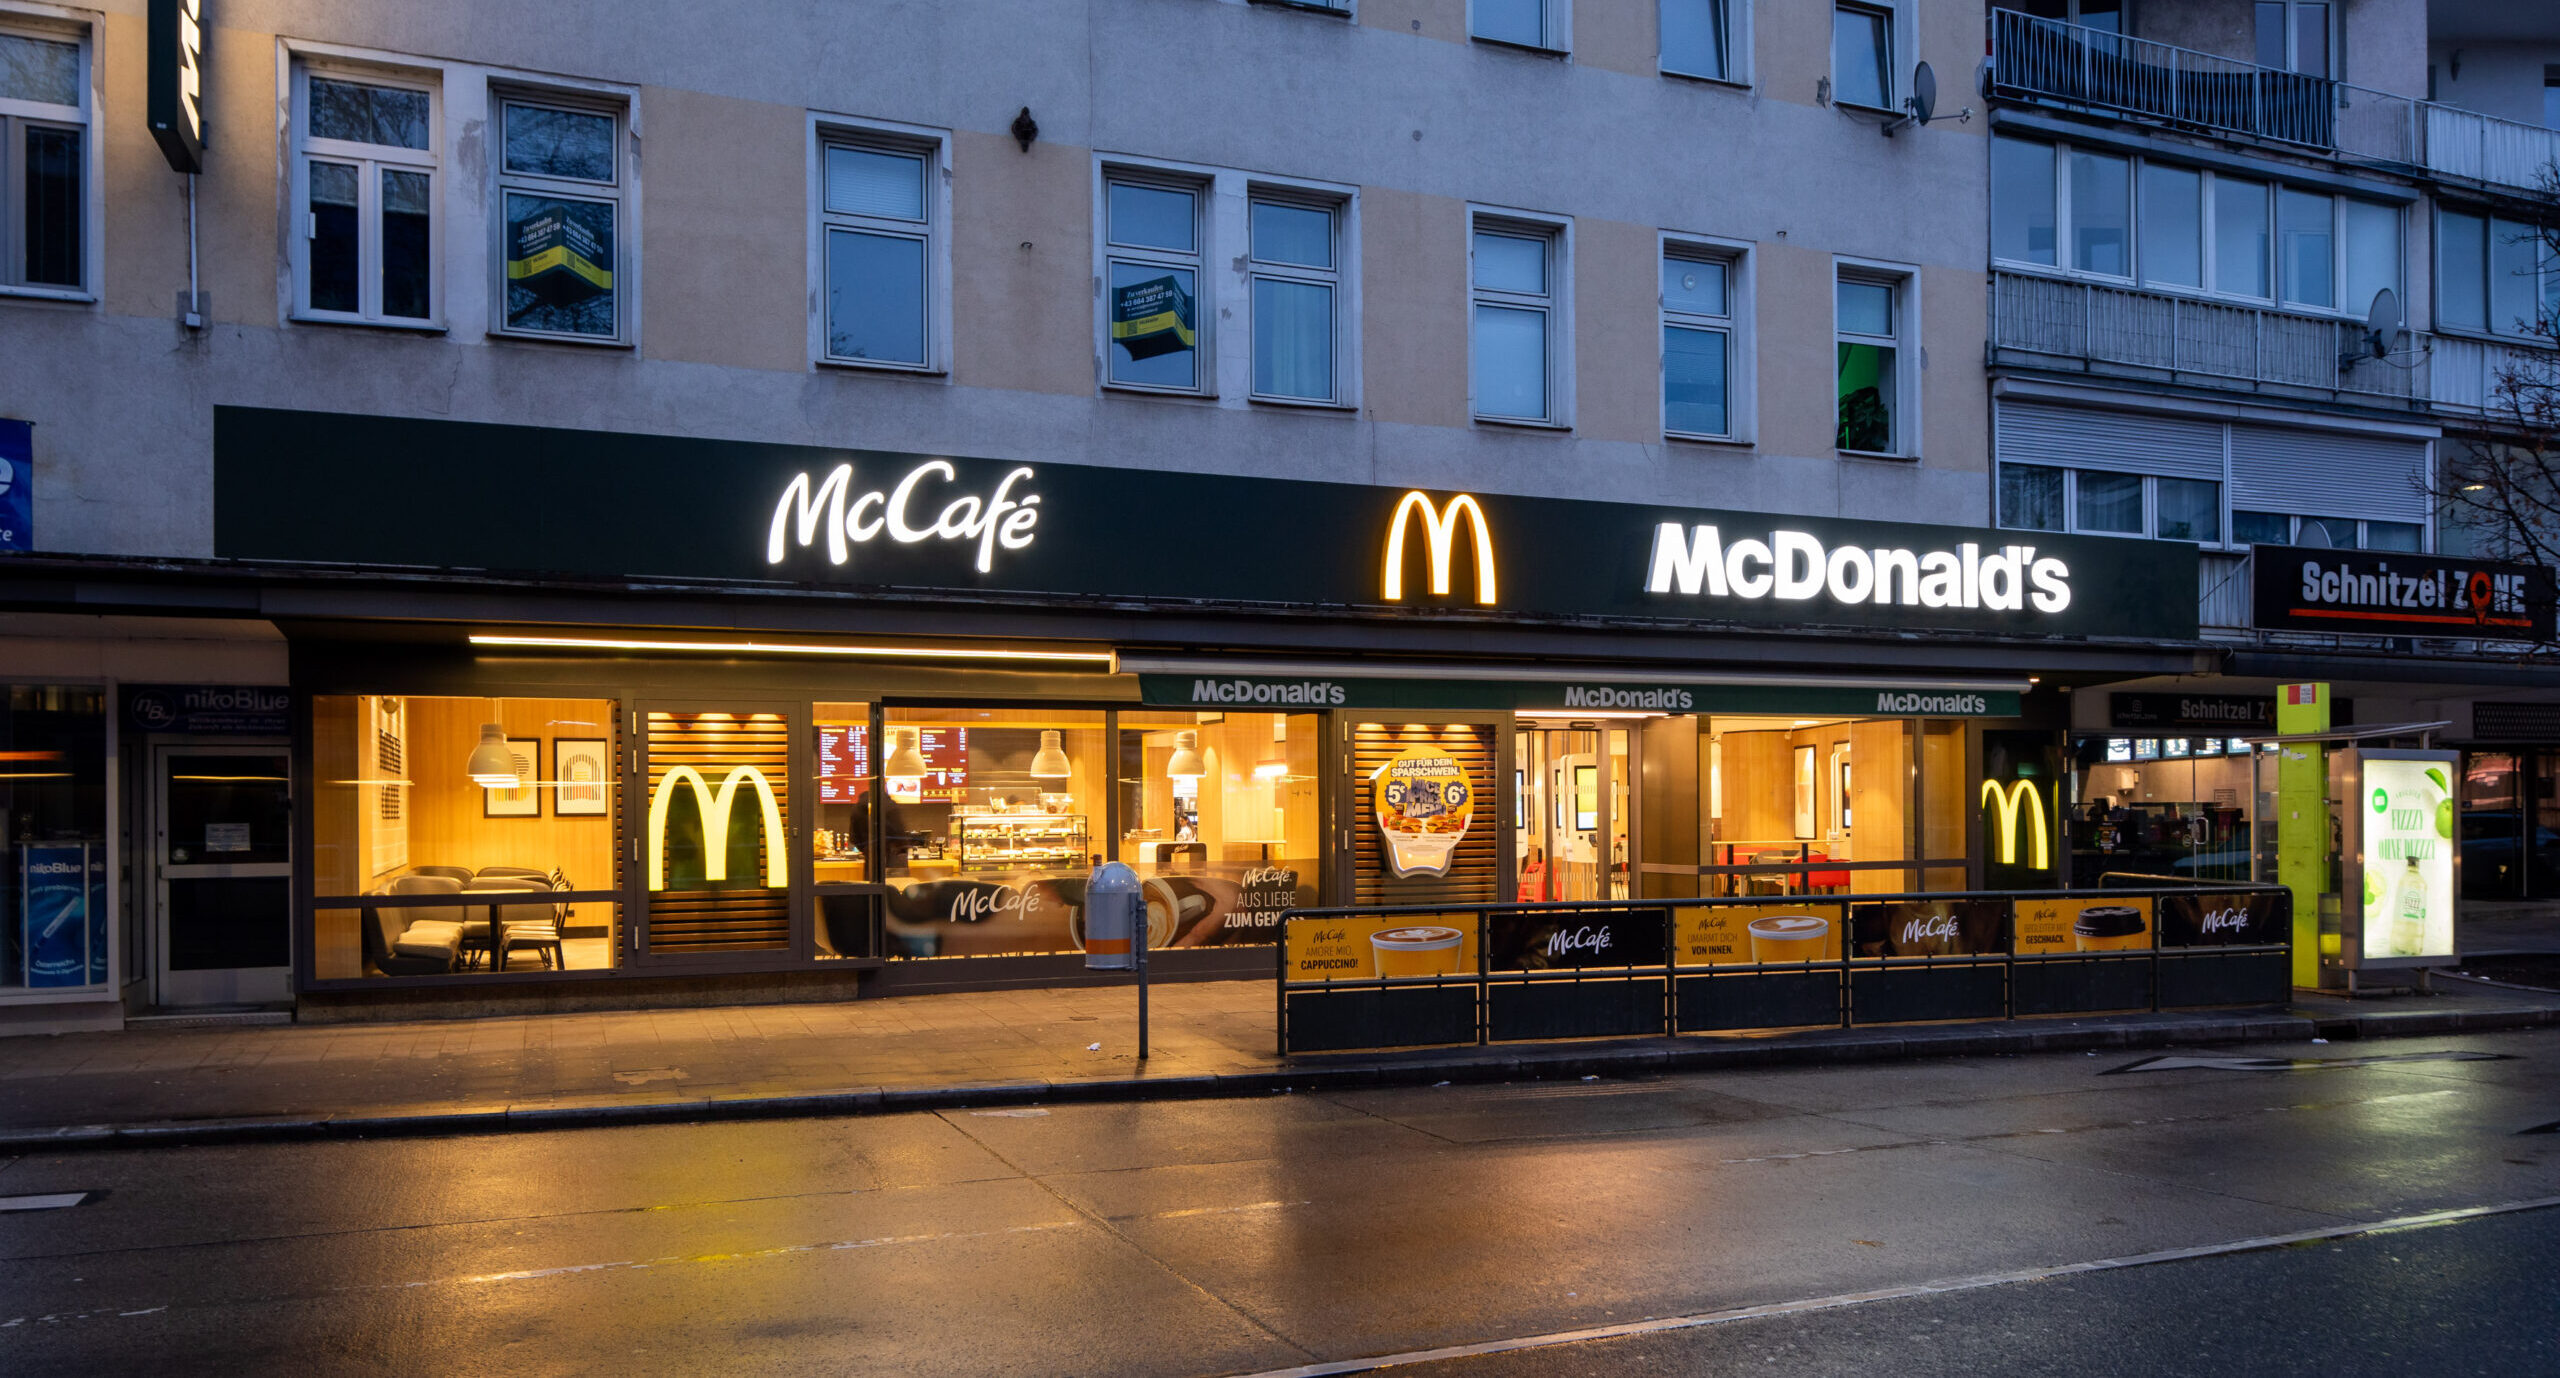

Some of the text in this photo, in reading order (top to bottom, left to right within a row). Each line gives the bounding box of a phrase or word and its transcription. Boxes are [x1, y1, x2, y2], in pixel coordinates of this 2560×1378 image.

[768, 461, 1040, 573] McCafé
[1651, 523, 2070, 614] McDonald's
[2302, 561, 2527, 620] Schnitzel ZONE
[185, 690, 289, 711] nikoBlue
[1192, 680, 1345, 704] McDonald's
[1565, 687, 1693, 709] McDonald's
[1877, 693, 1986, 713] McDonald's
[2180, 699, 2252, 720] Schnitzel
[1391, 766, 1460, 777] SPARSCHWEIN.
[1398, 757, 1453, 768] GUT FÜR DEIN
[30, 862, 82, 874] nikoBlue
[1242, 866, 1291, 888] McCafé
[950, 884, 1041, 922] McCafé
[1236, 891, 1296, 908] AUS LIEBE
[1224, 911, 1288, 928] ZUM GEN
[1902, 915, 1957, 943] McCafé
[2202, 907, 2247, 933] McCafé
[1314, 929, 1345, 943] McCafé
[1548, 925, 1610, 956] McCafé
[1688, 932, 1738, 944] UMARMT DICH
[1305, 945, 1333, 957] AMORE
[1692, 945, 1734, 956] VON INNEN.
[1301, 959, 1358, 970] CAPPUCCINO!
